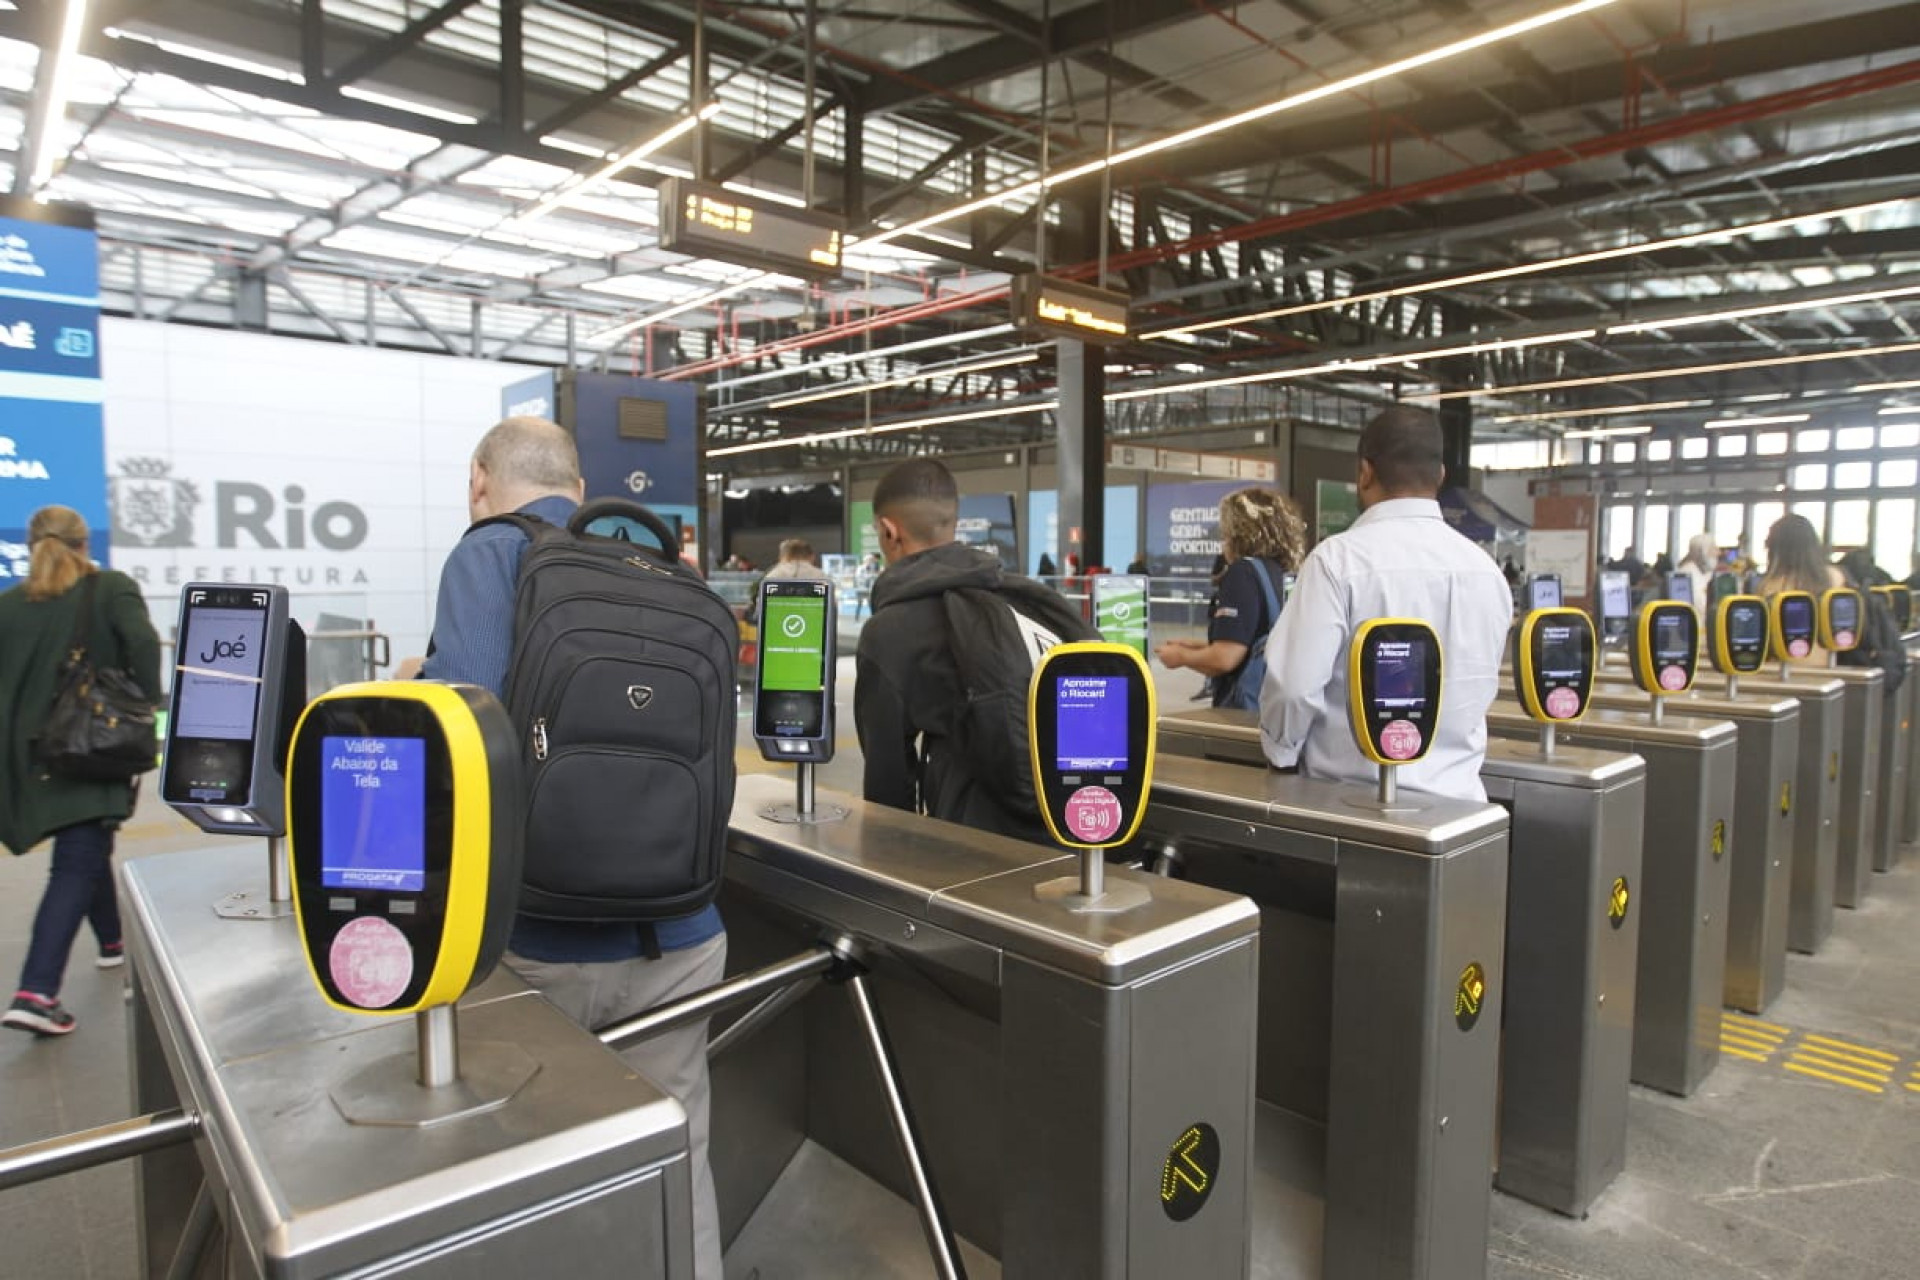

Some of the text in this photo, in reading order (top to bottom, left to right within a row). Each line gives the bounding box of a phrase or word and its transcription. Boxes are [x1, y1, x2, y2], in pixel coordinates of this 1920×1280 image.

[215, 481, 369, 552] Rio
[1169, 507, 1221, 523] GENTILE
[1169, 541, 1224, 554] OPORTUN
[130, 565, 369, 586] REFEITURA
[200, 634, 247, 664] Jaé
[344, 739, 387, 754] Valide
[331, 756, 399, 771] Abaixo da
[352, 773, 381, 788] Tela
